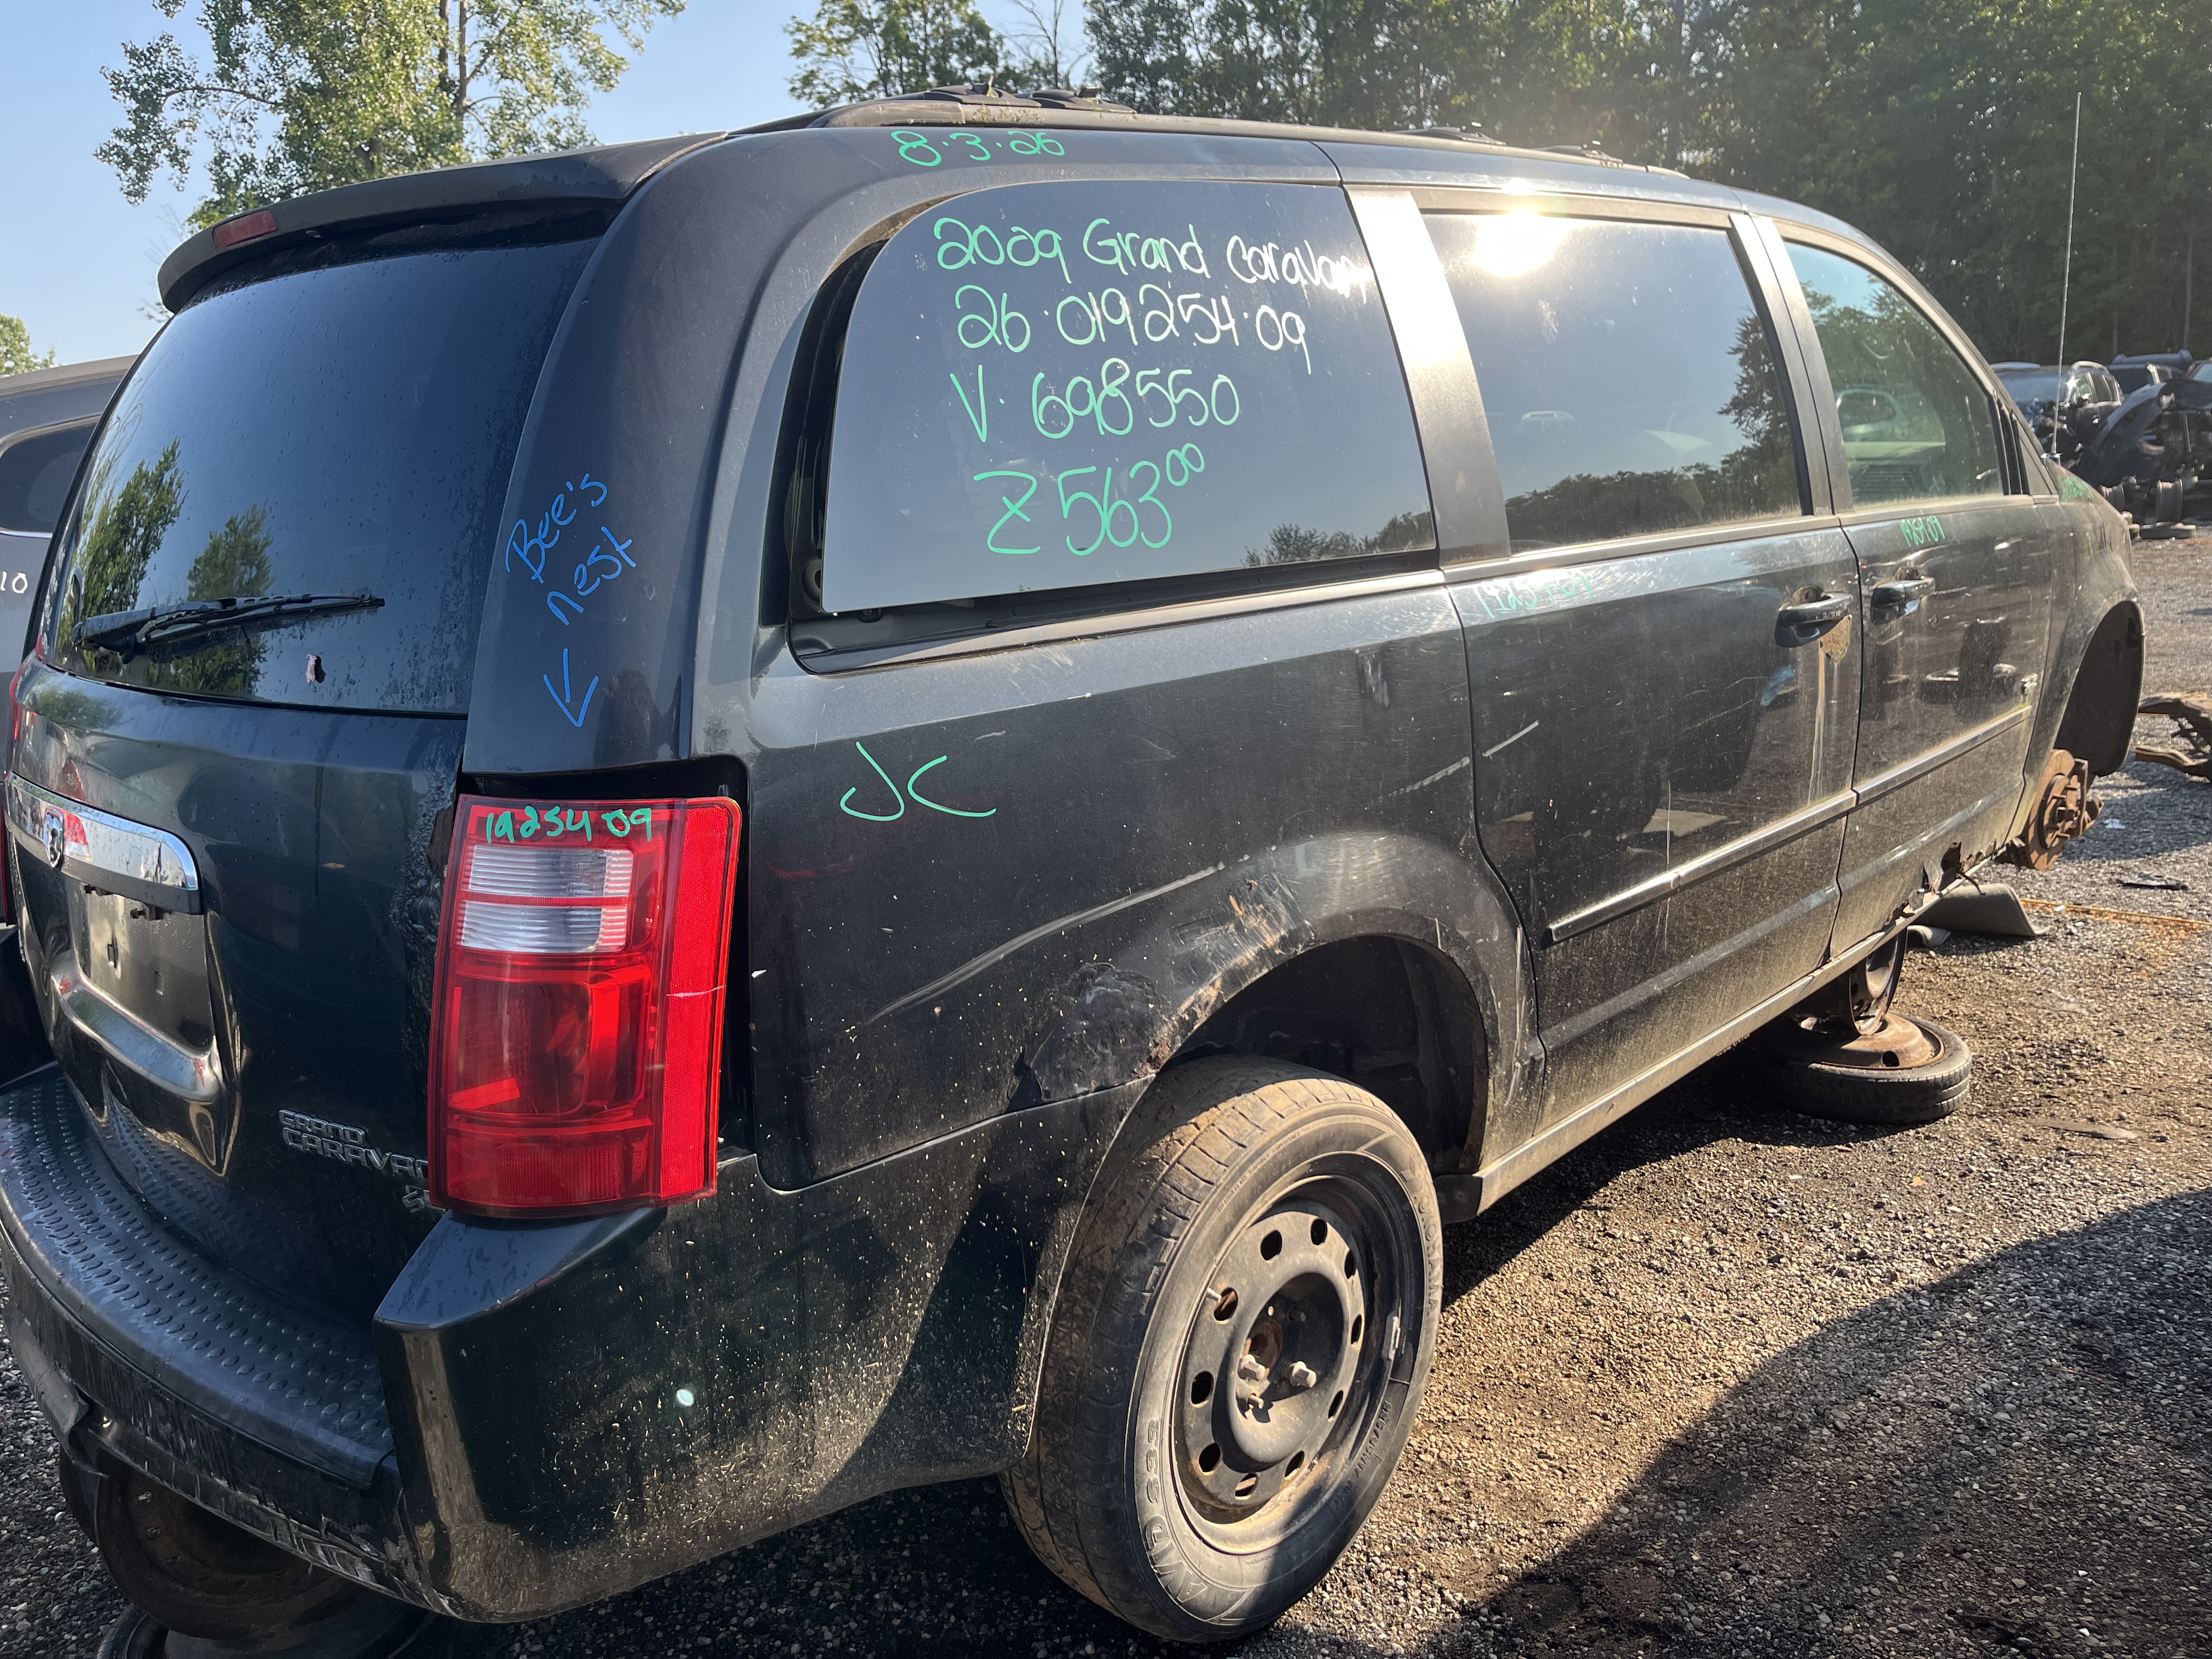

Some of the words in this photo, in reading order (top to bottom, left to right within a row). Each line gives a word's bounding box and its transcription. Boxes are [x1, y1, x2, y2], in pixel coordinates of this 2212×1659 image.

[933, 217, 1073, 284] 2009
[1083, 218, 1211, 279] Grand
[1226, 235, 1367, 304] Caravan
[1032, 358, 1240, 439] 698550
[506, 473, 607, 584] Bee's
[973, 470, 1042, 555] Z
[547, 526, 637, 626] nest
[840, 741, 996, 821] JC
[279, 1109, 366, 1144] GRAND
[1147, 1419, 1160, 1504] S33
[1145, 1515, 1208, 1603] AVID
